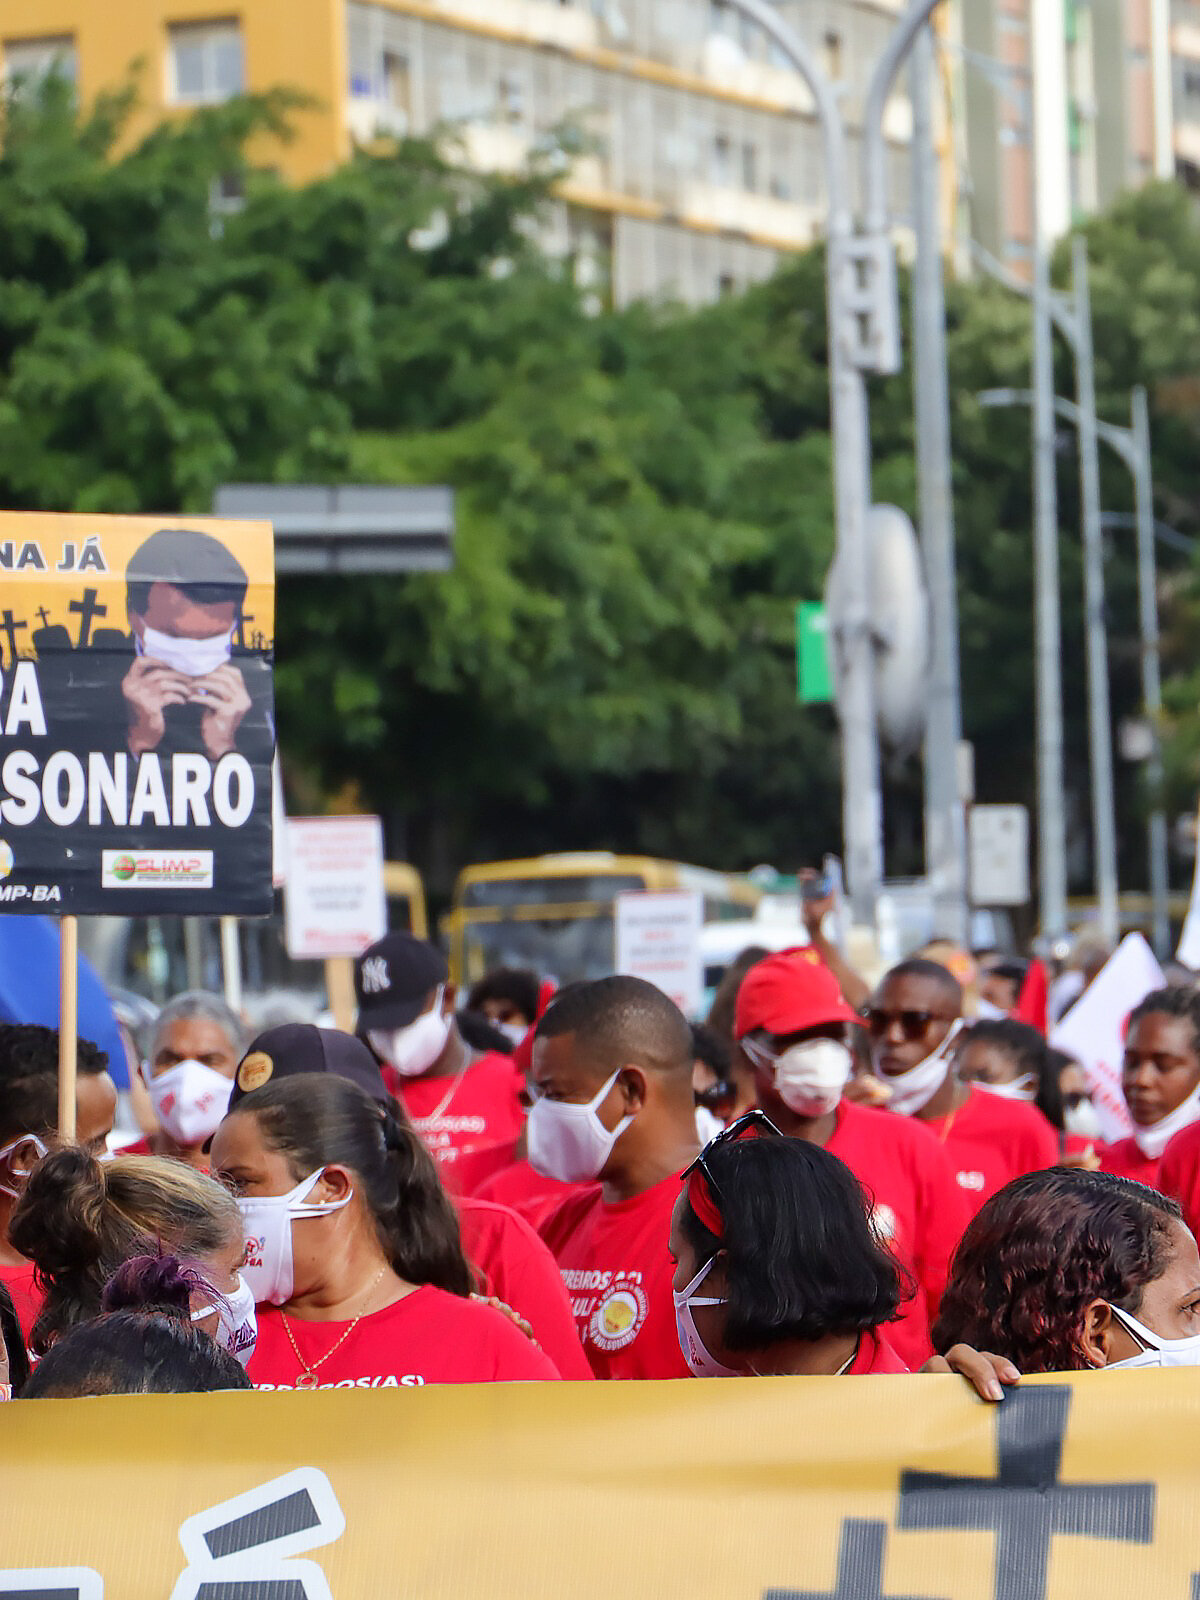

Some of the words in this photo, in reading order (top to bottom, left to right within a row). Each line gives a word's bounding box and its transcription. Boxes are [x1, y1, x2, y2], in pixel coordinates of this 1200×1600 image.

[57, 533, 108, 573] JÁ
[0, 660, 48, 736] A
[0, 749, 255, 827] SONARO
